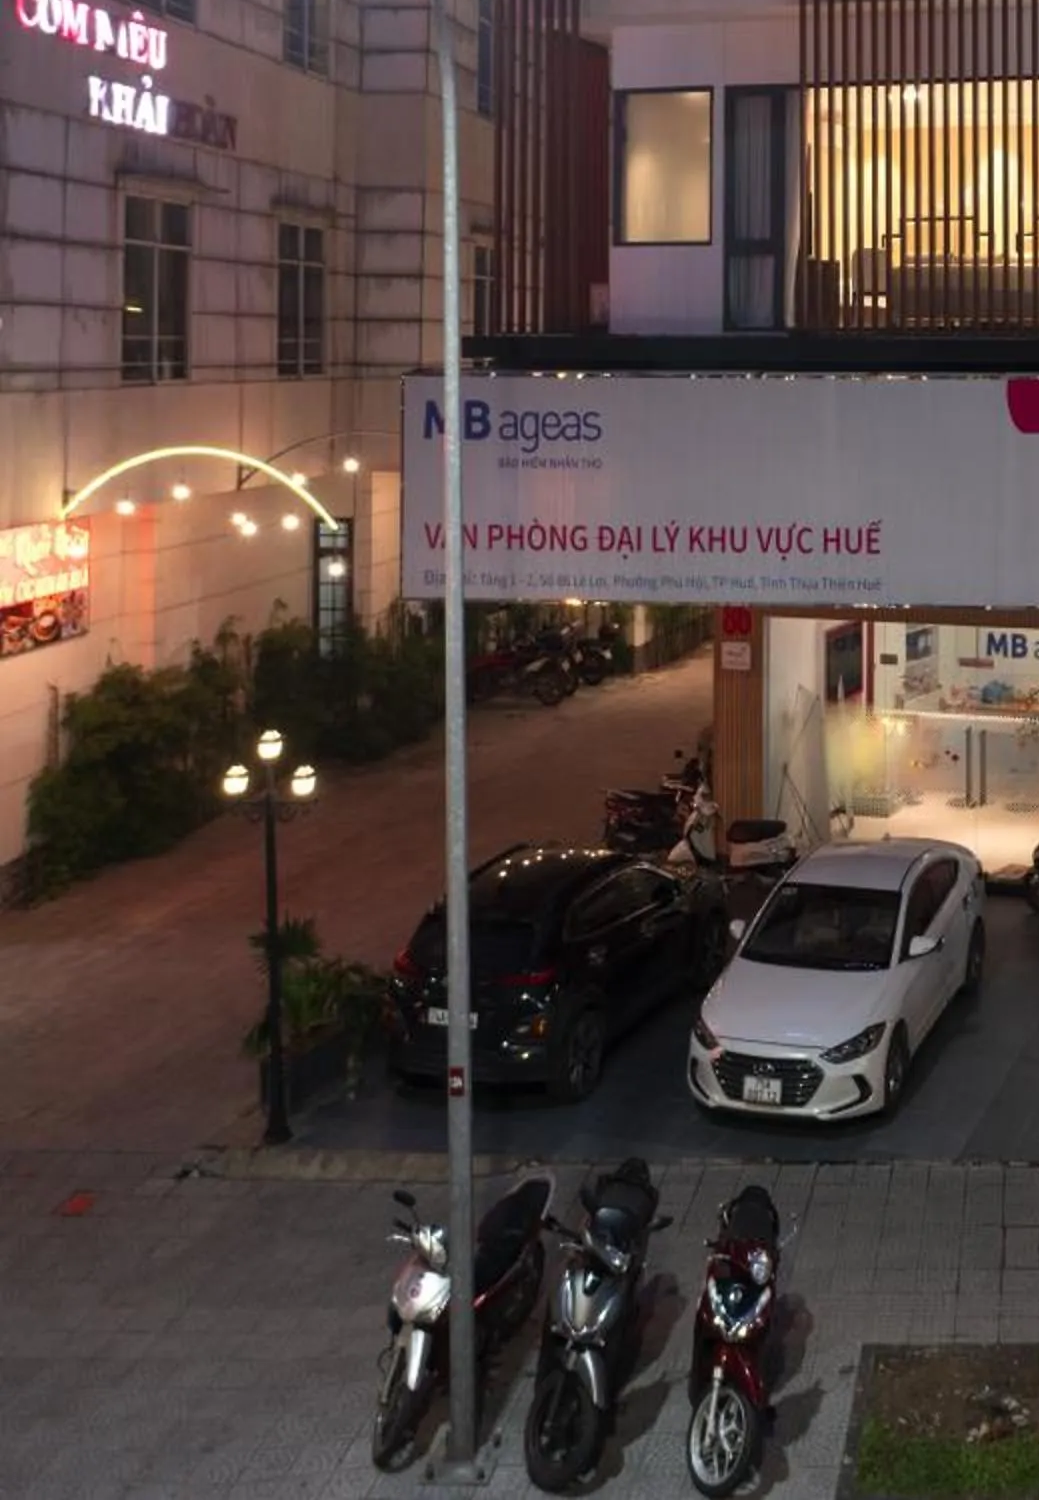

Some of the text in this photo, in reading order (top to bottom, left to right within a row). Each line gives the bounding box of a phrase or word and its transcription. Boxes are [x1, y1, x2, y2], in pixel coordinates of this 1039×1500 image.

[498, 409, 603, 453] ageas
[423, 518, 883, 562] VN PHÒNG ĐẠI LÝ KHU VỰC HUẾ
[986, 632, 1028, 659] MB
